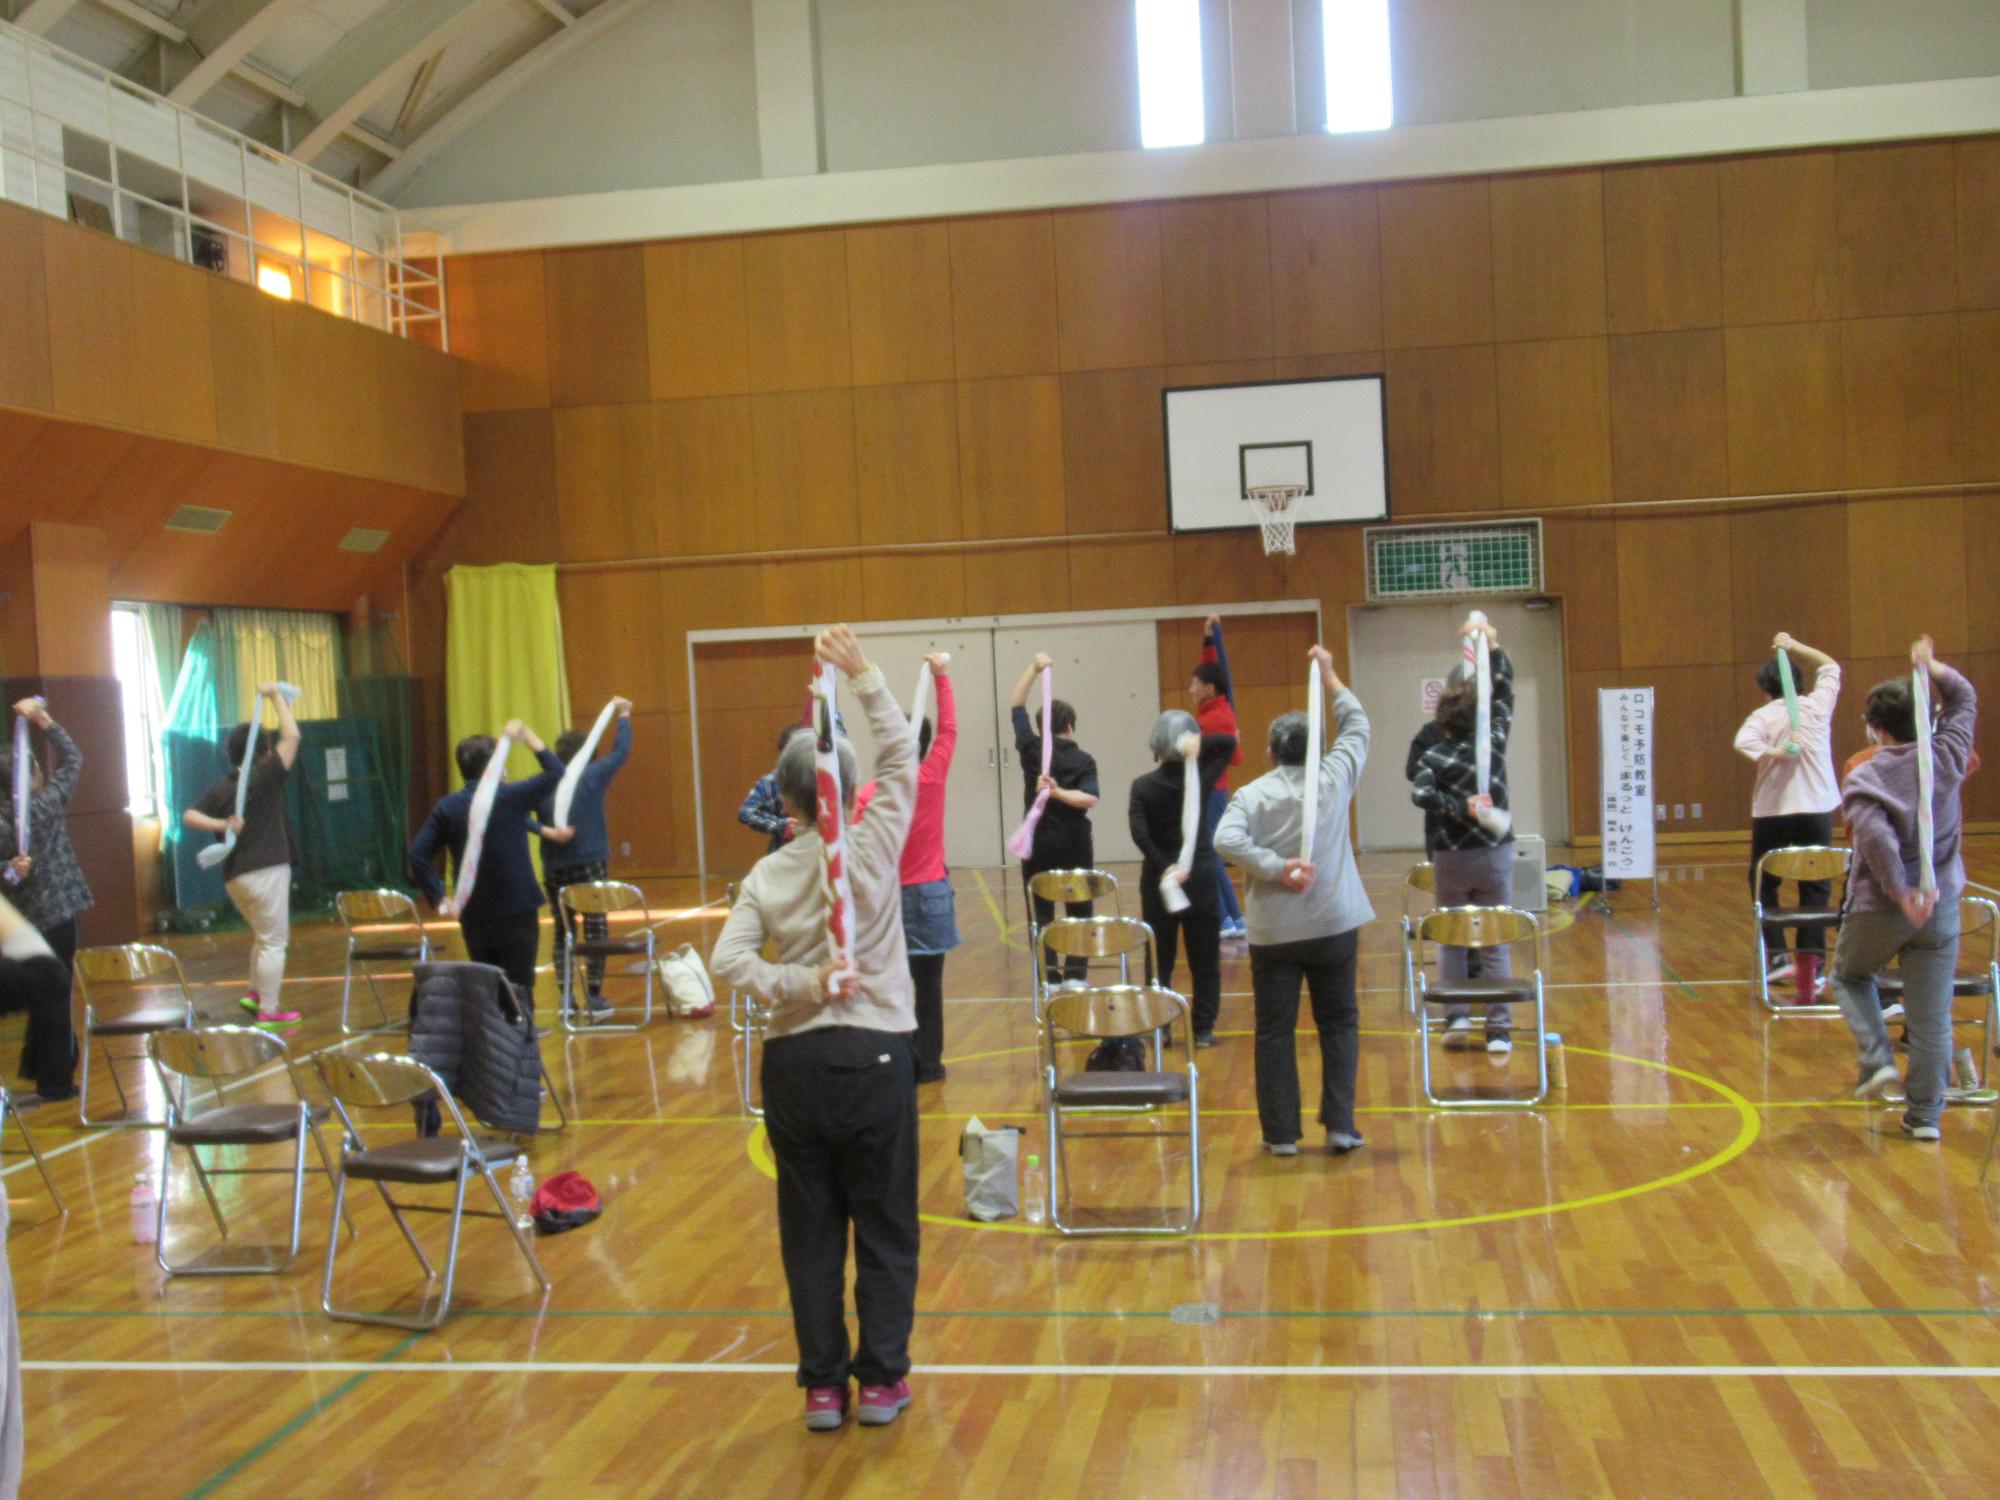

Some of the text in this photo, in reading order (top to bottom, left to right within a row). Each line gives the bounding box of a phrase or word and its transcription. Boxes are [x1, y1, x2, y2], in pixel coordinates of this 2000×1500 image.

[1634, 693, 1646, 797] ロコモ予防教室
